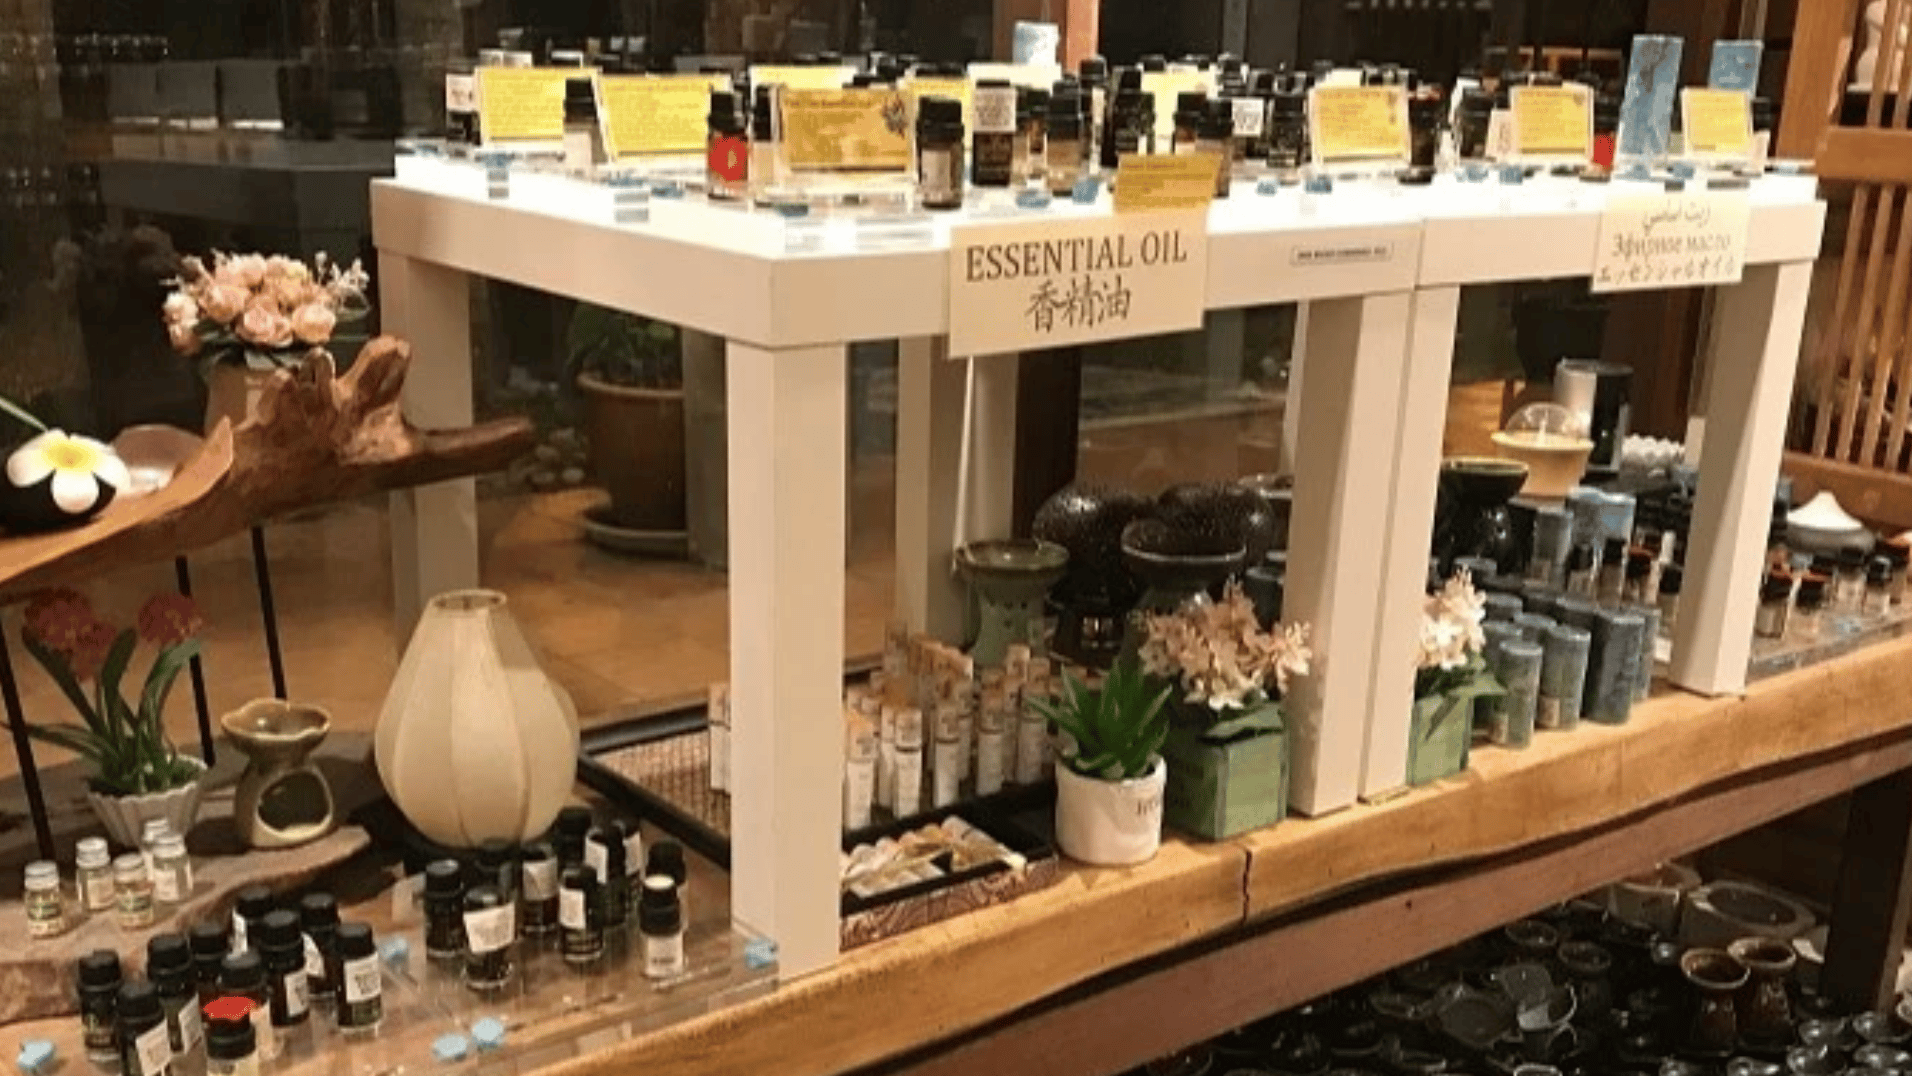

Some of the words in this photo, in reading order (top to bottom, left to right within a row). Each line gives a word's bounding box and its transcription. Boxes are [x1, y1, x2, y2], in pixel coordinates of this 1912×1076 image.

[966, 235, 1133, 282] ESSENTIAL
[1140, 230, 1187, 266] OIL
[1024, 274, 1131, 333] 香精油
